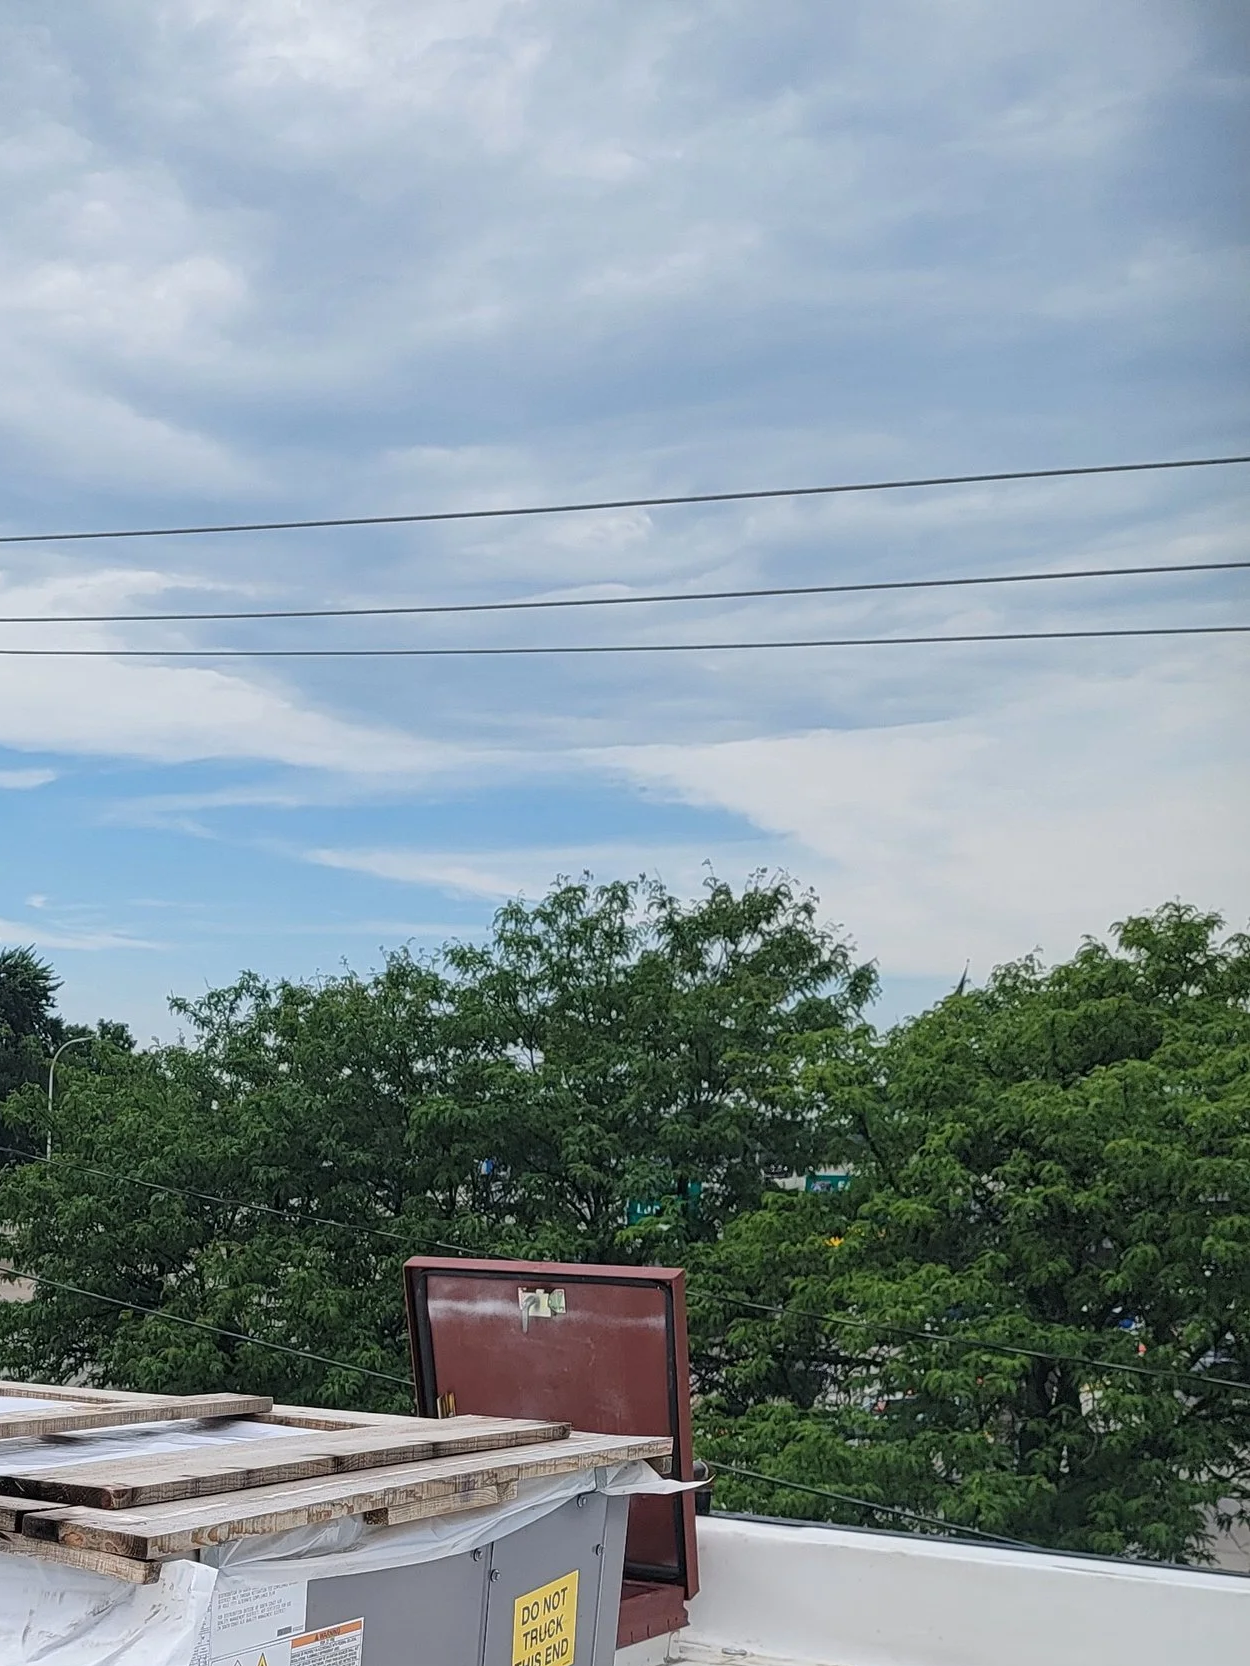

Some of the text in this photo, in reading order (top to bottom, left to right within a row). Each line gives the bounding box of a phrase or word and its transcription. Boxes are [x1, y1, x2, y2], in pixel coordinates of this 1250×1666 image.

[521, 1587, 568, 1626] DO NOT
[523, 1614, 564, 1651] TRUCK
[544, 1638, 569, 1666] END
